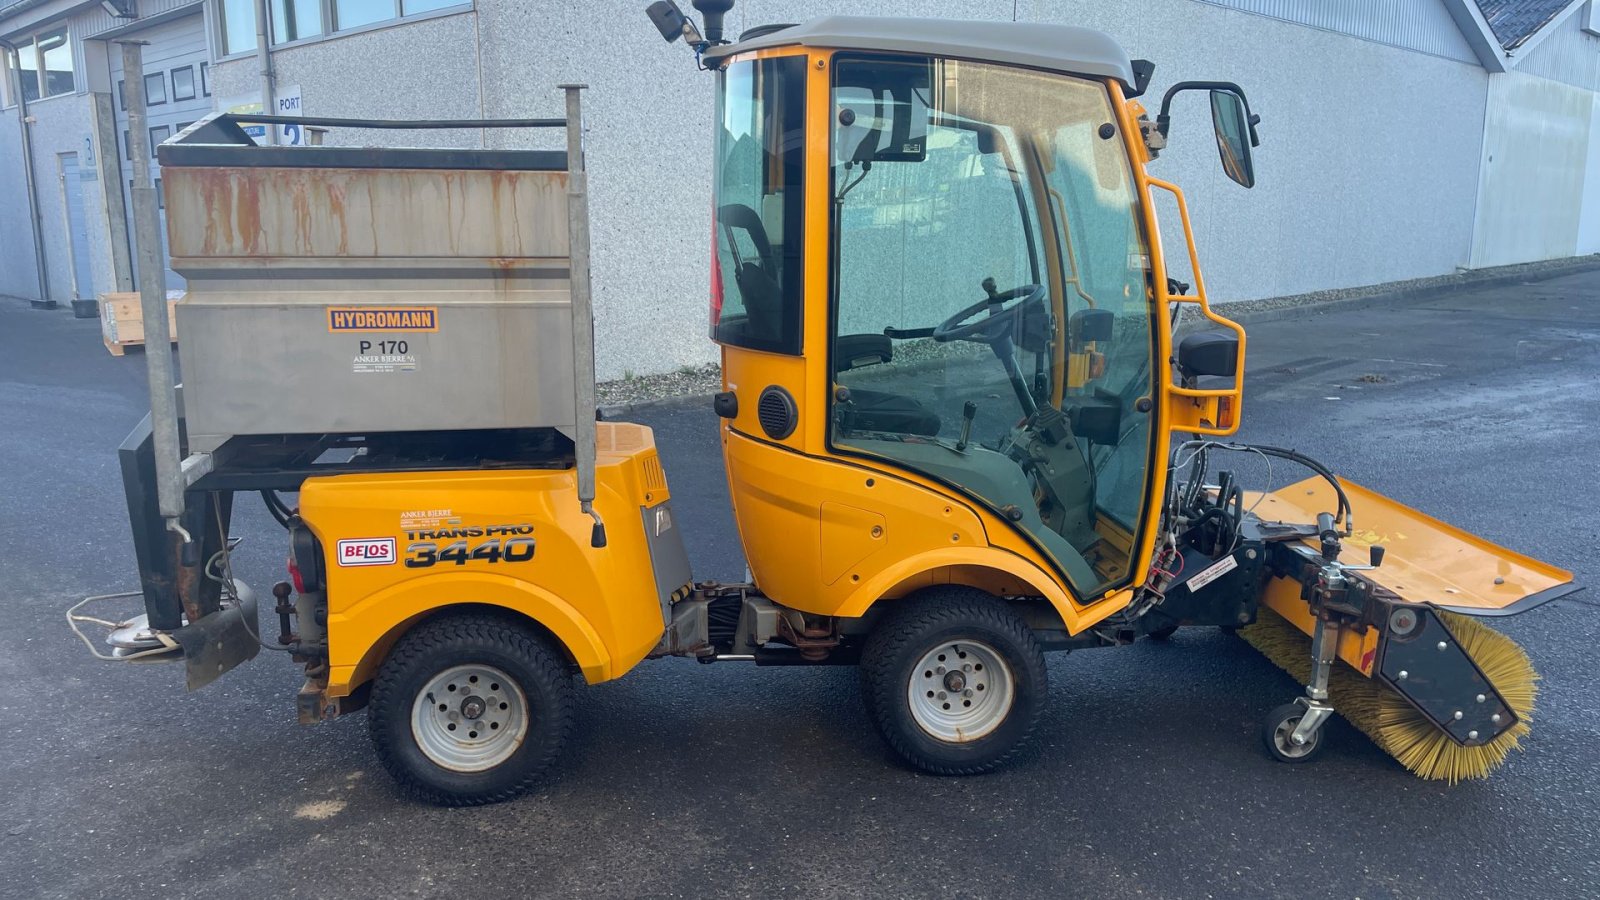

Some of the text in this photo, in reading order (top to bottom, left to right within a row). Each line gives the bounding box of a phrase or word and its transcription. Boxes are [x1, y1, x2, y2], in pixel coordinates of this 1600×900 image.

[280, 97, 300, 110] PORT
[334, 311, 432, 328] HYDROMANN
[360, 340, 409, 355] P 170
[353, 355, 380, 363] ANKER
[381, 355, 406, 363] BJERRE
[400, 511, 426, 519] ANKER
[402, 523, 534, 541] TRANS PRO
[344, 543, 390, 560] BELOS
[404, 537, 537, 569] 3440
